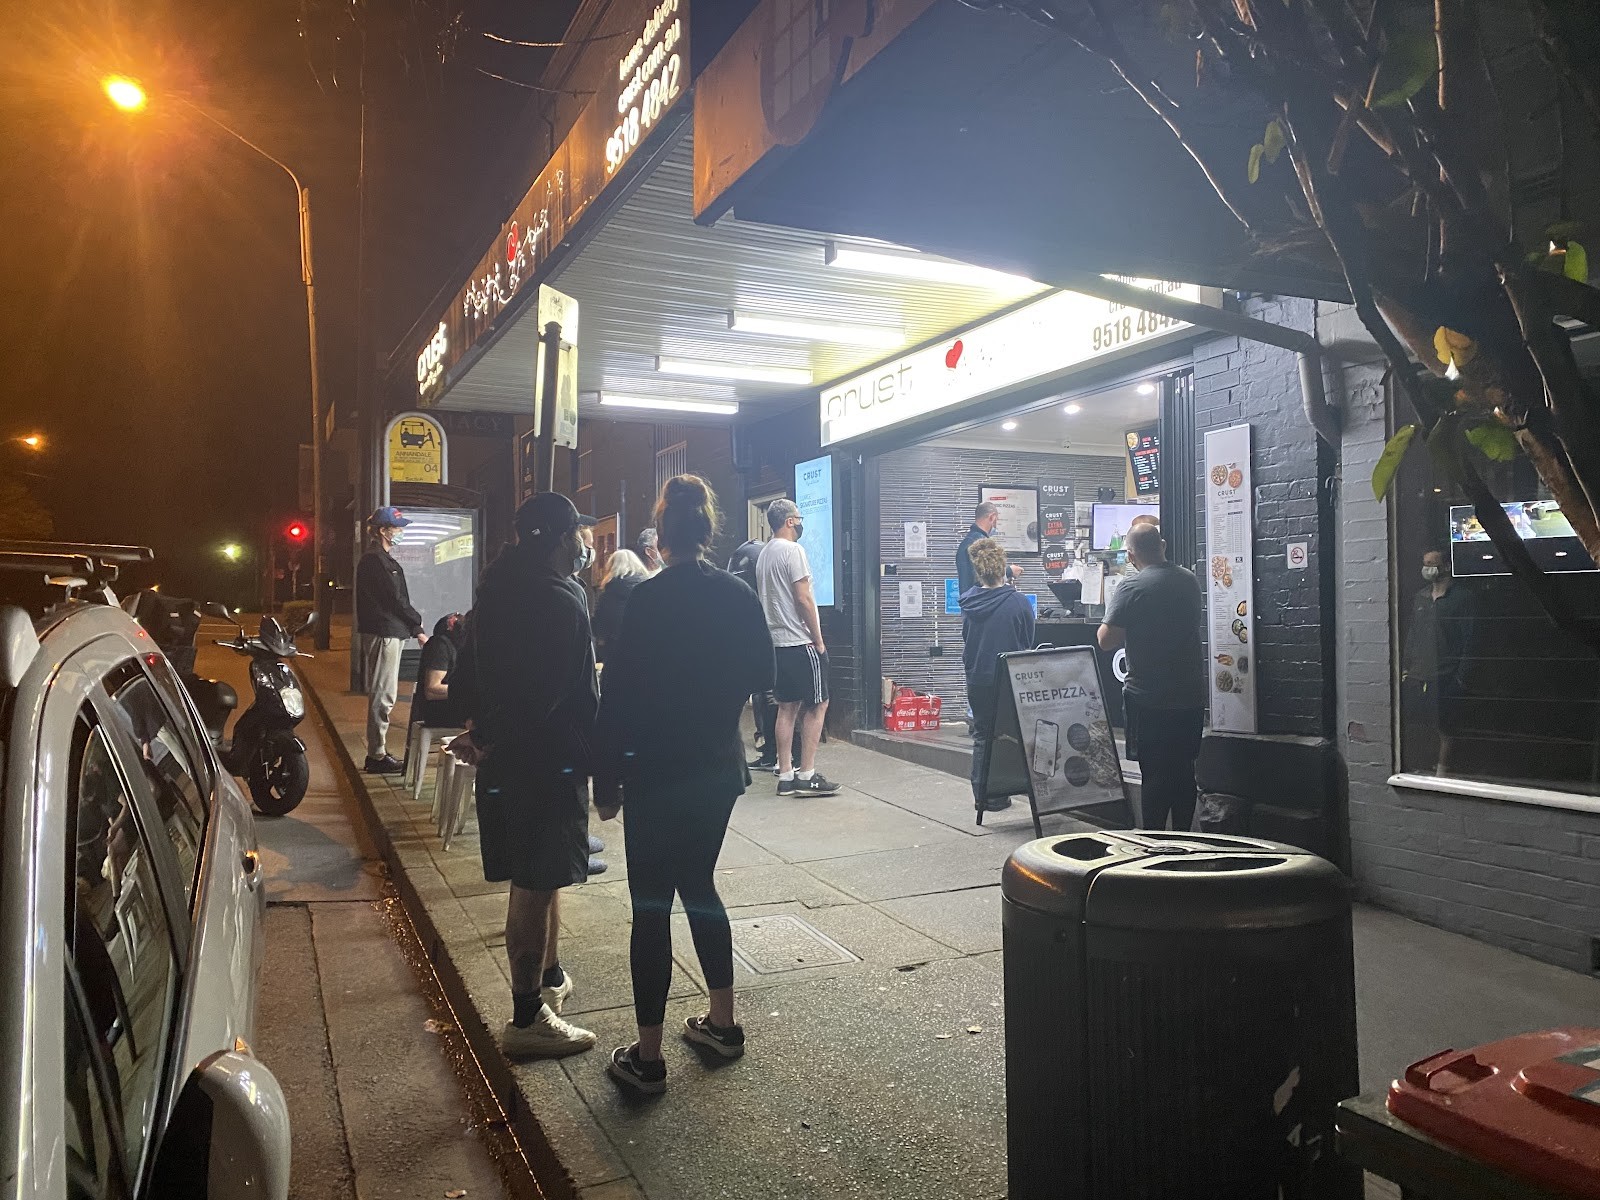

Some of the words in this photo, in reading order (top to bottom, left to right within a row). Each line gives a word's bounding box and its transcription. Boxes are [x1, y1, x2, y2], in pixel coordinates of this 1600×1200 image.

[606, 107, 640, 174] 9518
[641, 53, 680, 128] 4842
[1093, 316, 1131, 351] 9518
[1137, 310, 1180, 336] 484
[827, 363, 913, 419] crust
[424, 463, 438, 473] 04
[803, 469, 821, 480] CRUST
[1042, 485, 1069, 493] CRUST
[1217, 489, 1237, 497] CRUST
[1015, 671, 1045, 681] CRUST
[1019, 689, 1050, 704] FREE
[1051, 686, 1087, 700] PIZZA
